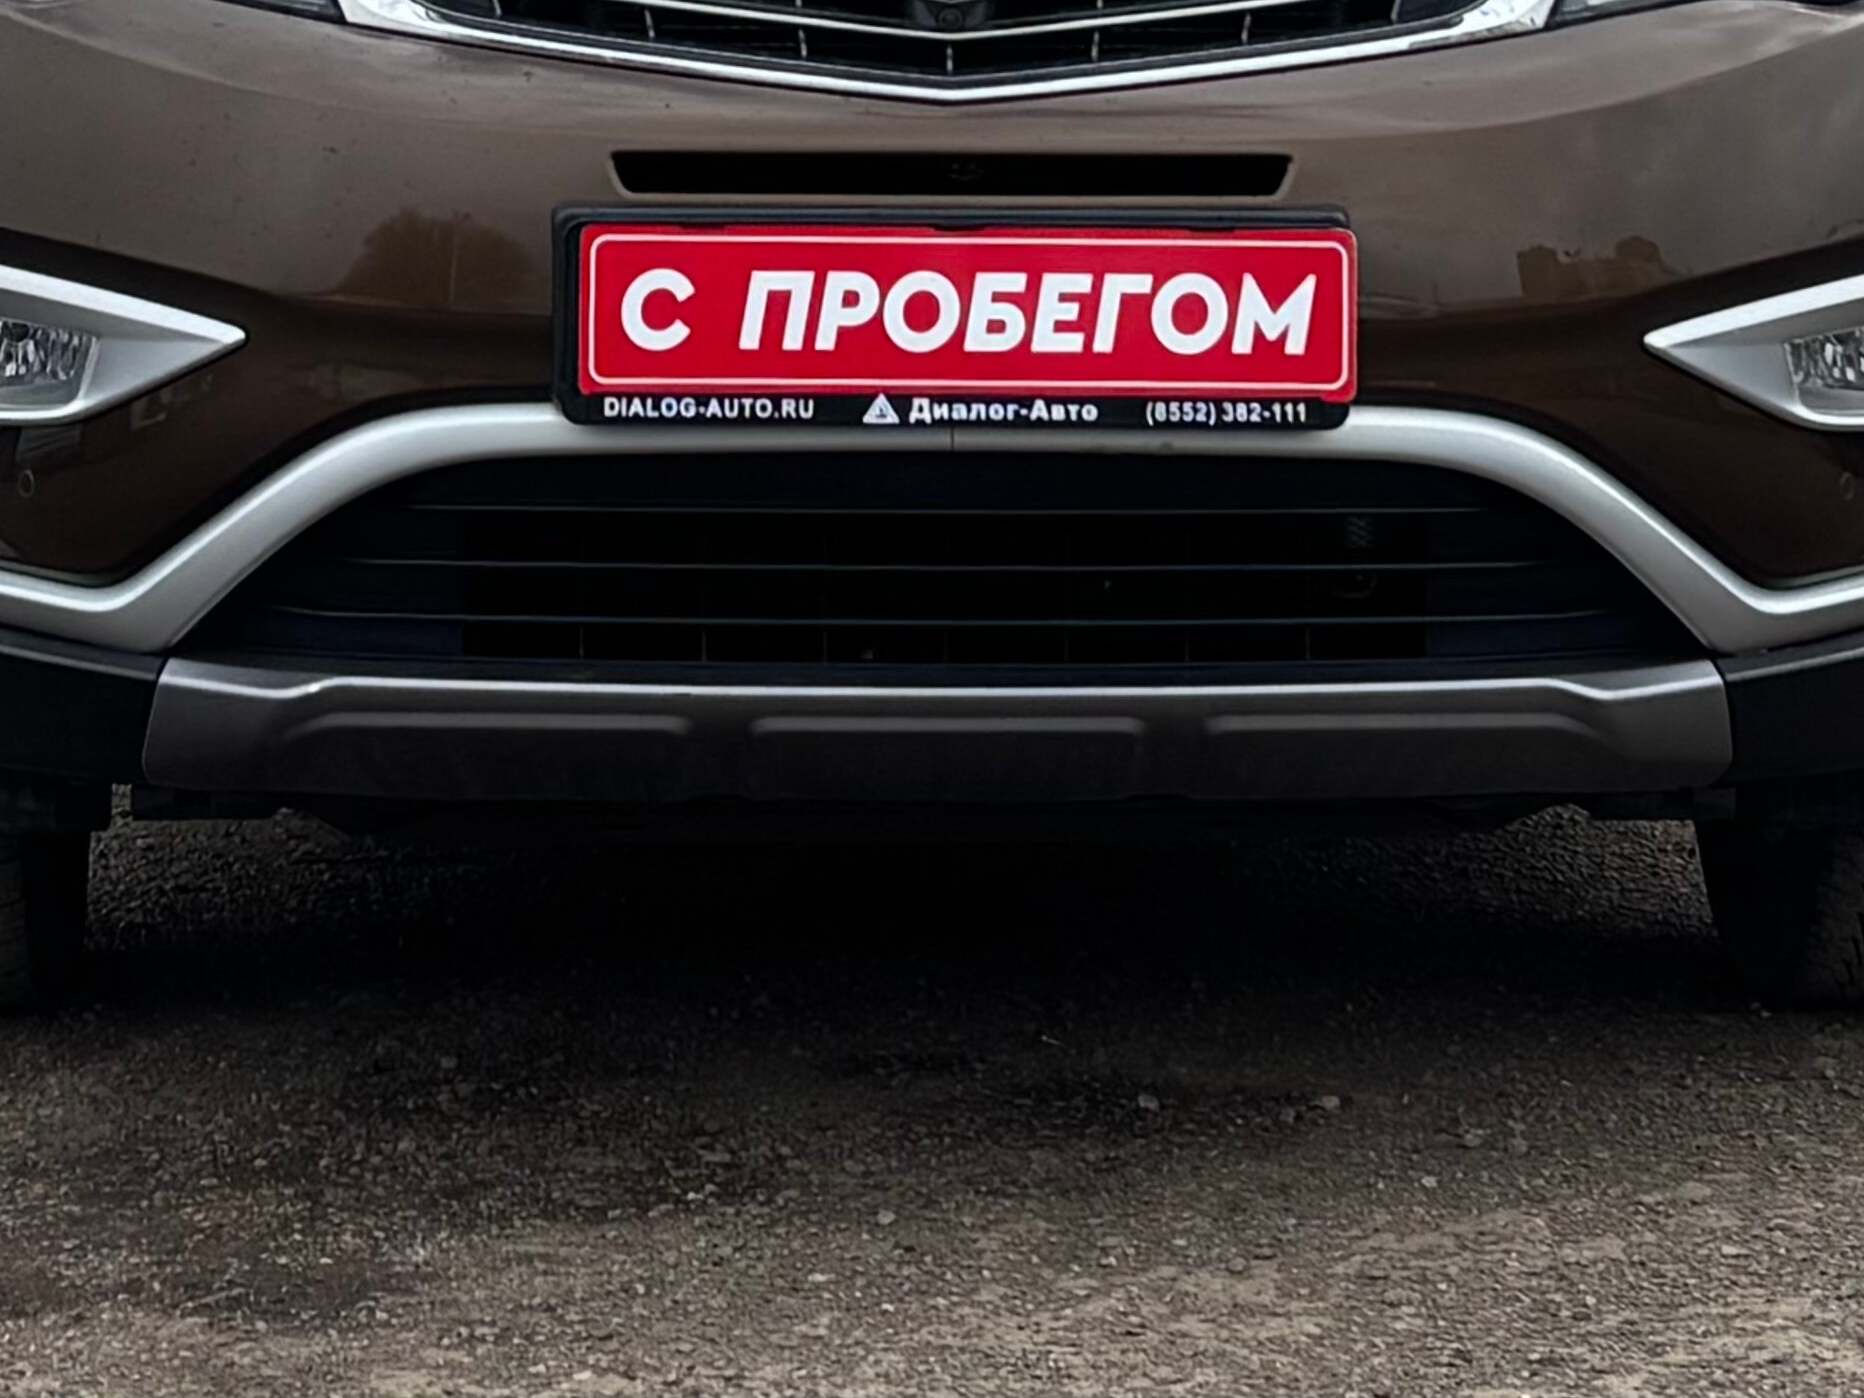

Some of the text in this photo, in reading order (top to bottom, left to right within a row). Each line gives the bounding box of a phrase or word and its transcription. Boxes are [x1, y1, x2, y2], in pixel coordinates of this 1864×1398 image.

[620, 267, 1319, 357] С ПРОБЕГОМ
[603, 397, 815, 420] DIALOG-AUTO.RU
[908, 397, 1099, 423] Диалог-Авто
[1145, 401, 1308, 425] (8552) 382-111
